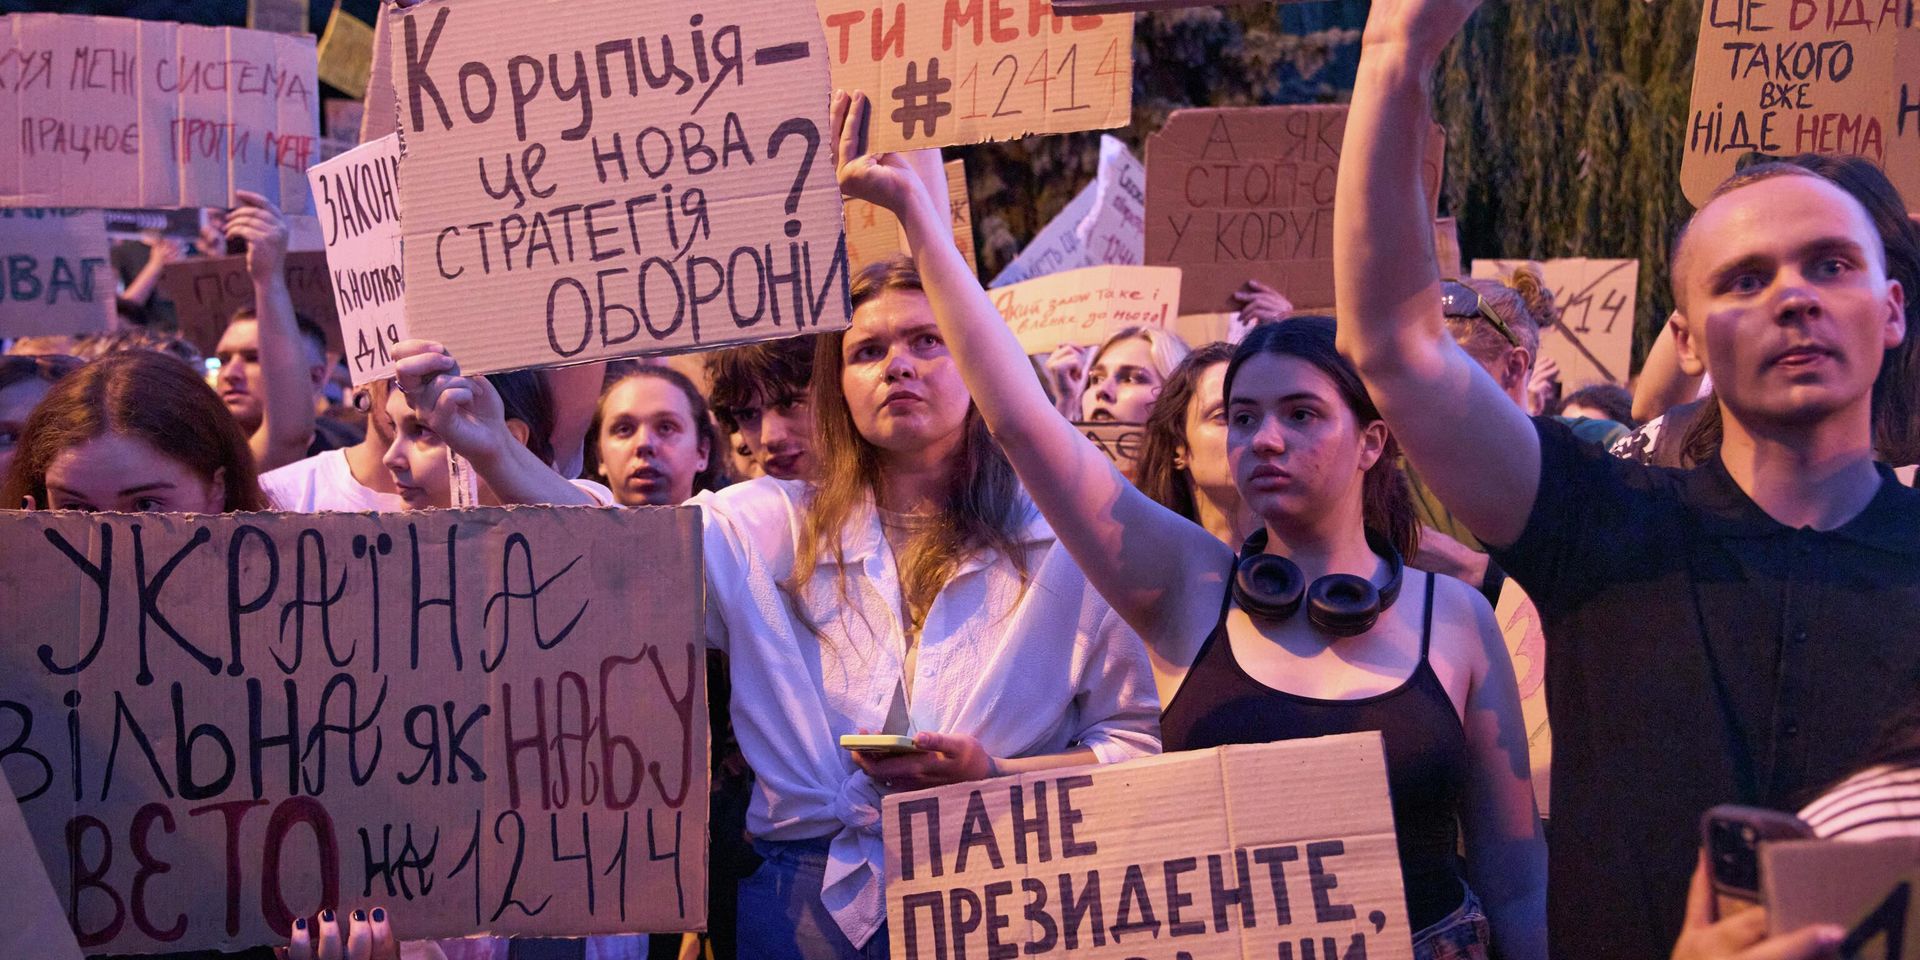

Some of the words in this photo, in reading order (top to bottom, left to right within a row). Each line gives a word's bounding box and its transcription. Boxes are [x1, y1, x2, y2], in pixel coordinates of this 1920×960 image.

[157, 56, 313, 110] СИСТЕМА
[403, 7, 744, 141] Корупція
[1723, 40, 1853, 83] ТАКОГО
[1760, 81, 1813, 110] ВЖЕ
[22, 117, 139, 164] ПРАЦЮЄ
[171, 118, 250, 163] ПРОТИ
[592, 111, 755, 183] НОВА
[1201, 114, 1238, 161] А
[1691, 102, 1781, 157] НІДЕ
[1796, 112, 1882, 161] НЕМА
[435, 183, 711, 280] СТРАТЕГІЯ
[1167, 214, 1192, 261] У
[546, 230, 852, 357] ОБОРОНИ
[37, 524, 589, 685] УКРАЇНА
[502, 642, 696, 811] НАБУ
[898, 775, 1097, 881] ПАНЕ
[65, 796, 340, 947] ВЕТО
[447, 809, 685, 926] 12414
[902, 840, 1387, 960] ПРЕЗИДЕНТЕ,
